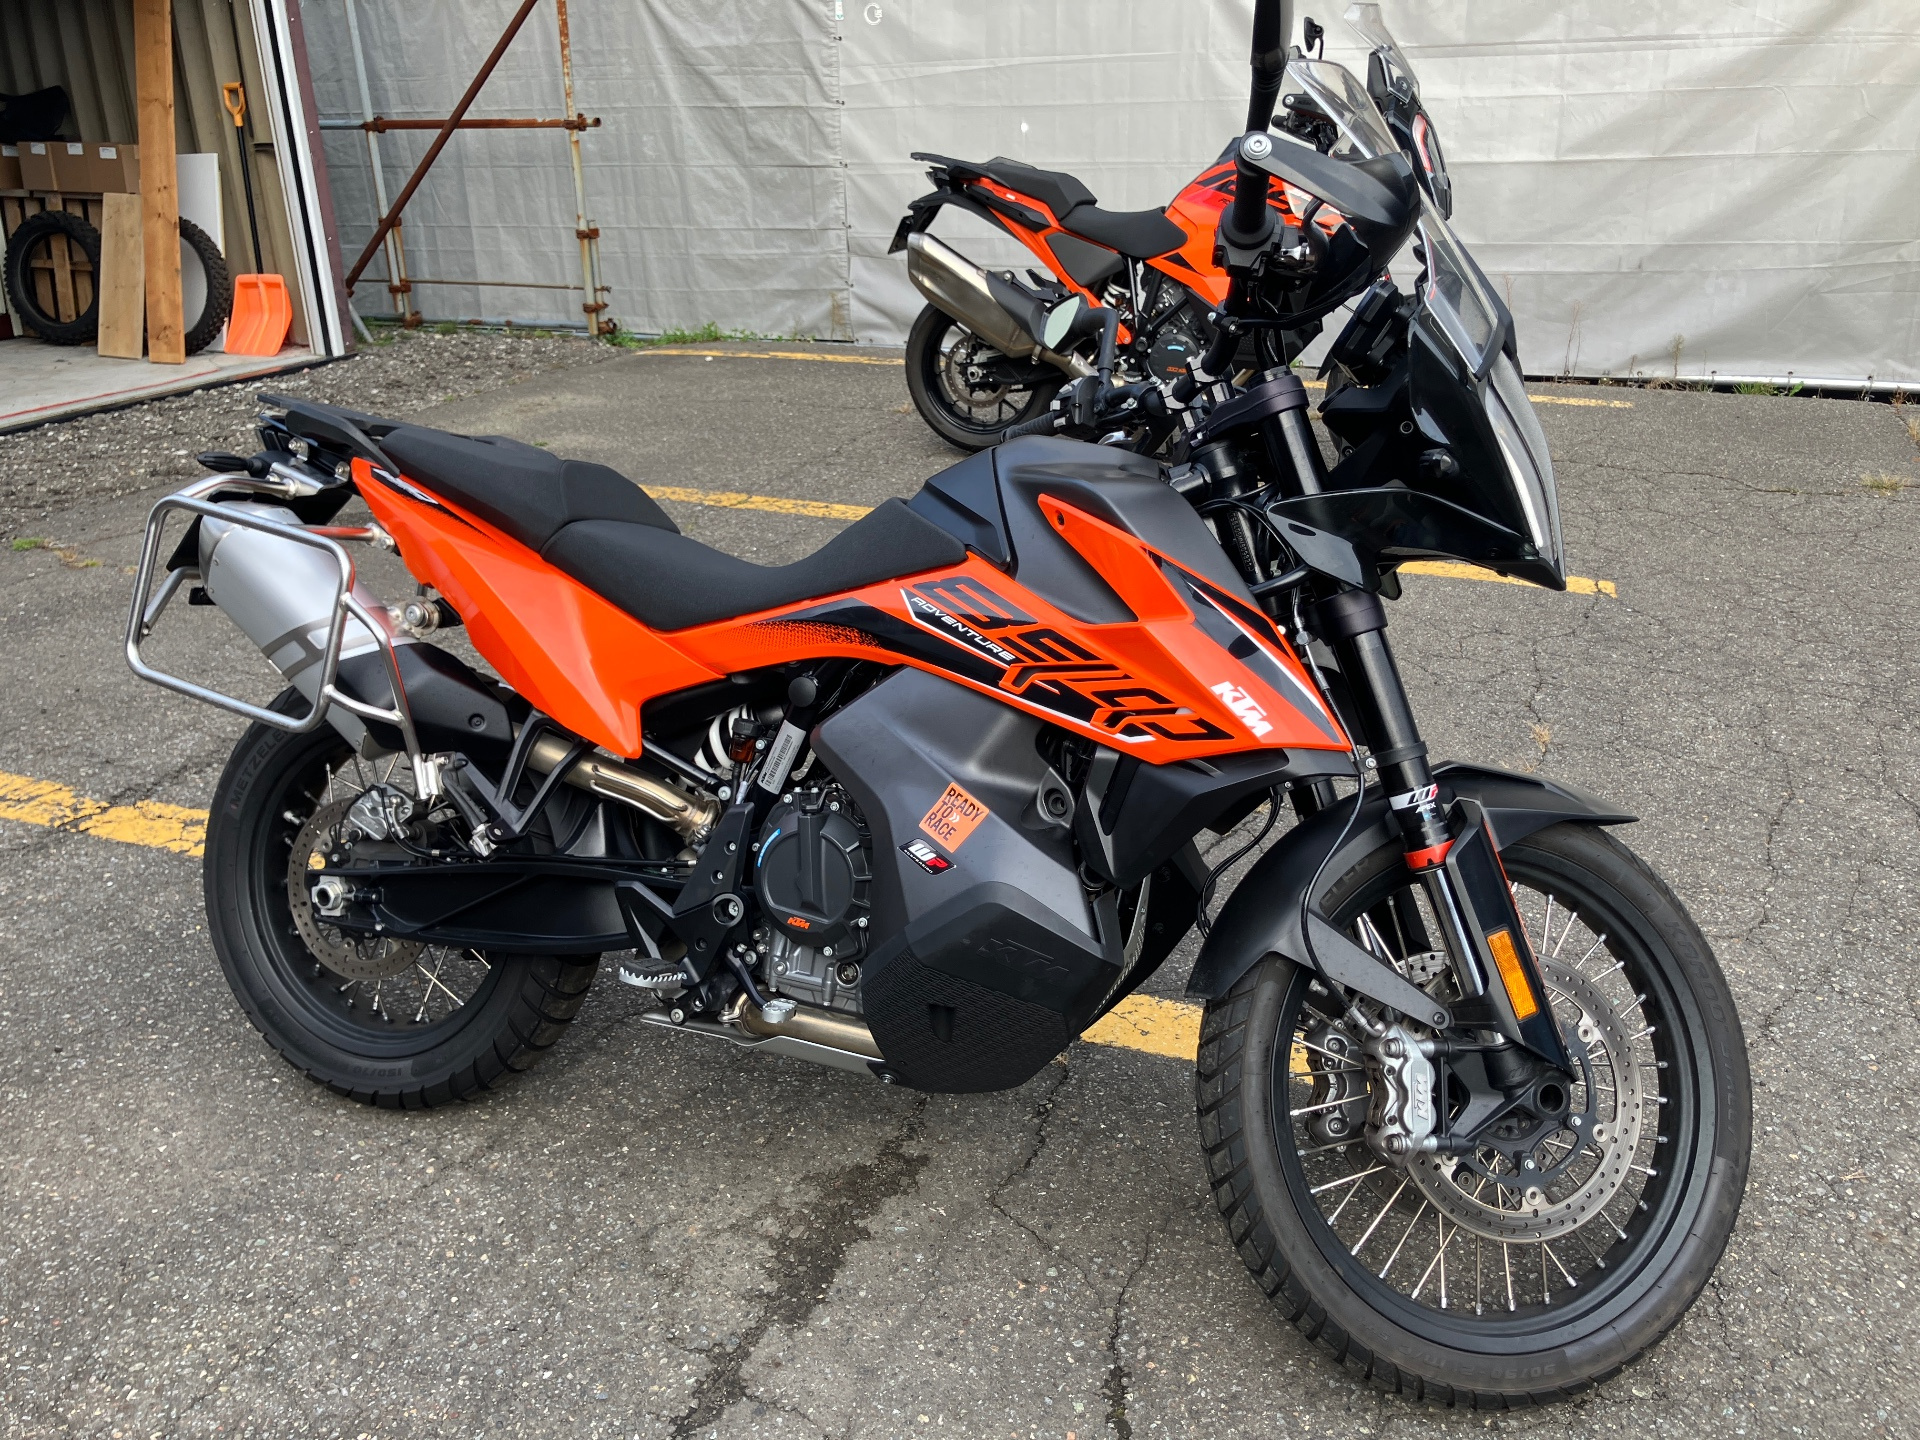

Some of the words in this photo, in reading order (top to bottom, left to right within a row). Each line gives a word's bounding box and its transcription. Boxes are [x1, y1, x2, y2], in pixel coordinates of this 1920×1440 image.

[911, 597, 1016, 661] ADVENTURE
[1210, 681, 1274, 737] KTM
[229, 728, 288, 805] METZELE
[936, 800, 953, 819] TO
[944, 787, 984, 822] READY
[1415, 801, 1437, 814] APEX
[924, 812, 957, 842] RACE
[907, 843, 949, 868] WP
[787, 916, 811, 930] KTM
[1663, 919, 1728, 1023] KAROO
[1413, 1072, 1429, 1121] KTM
